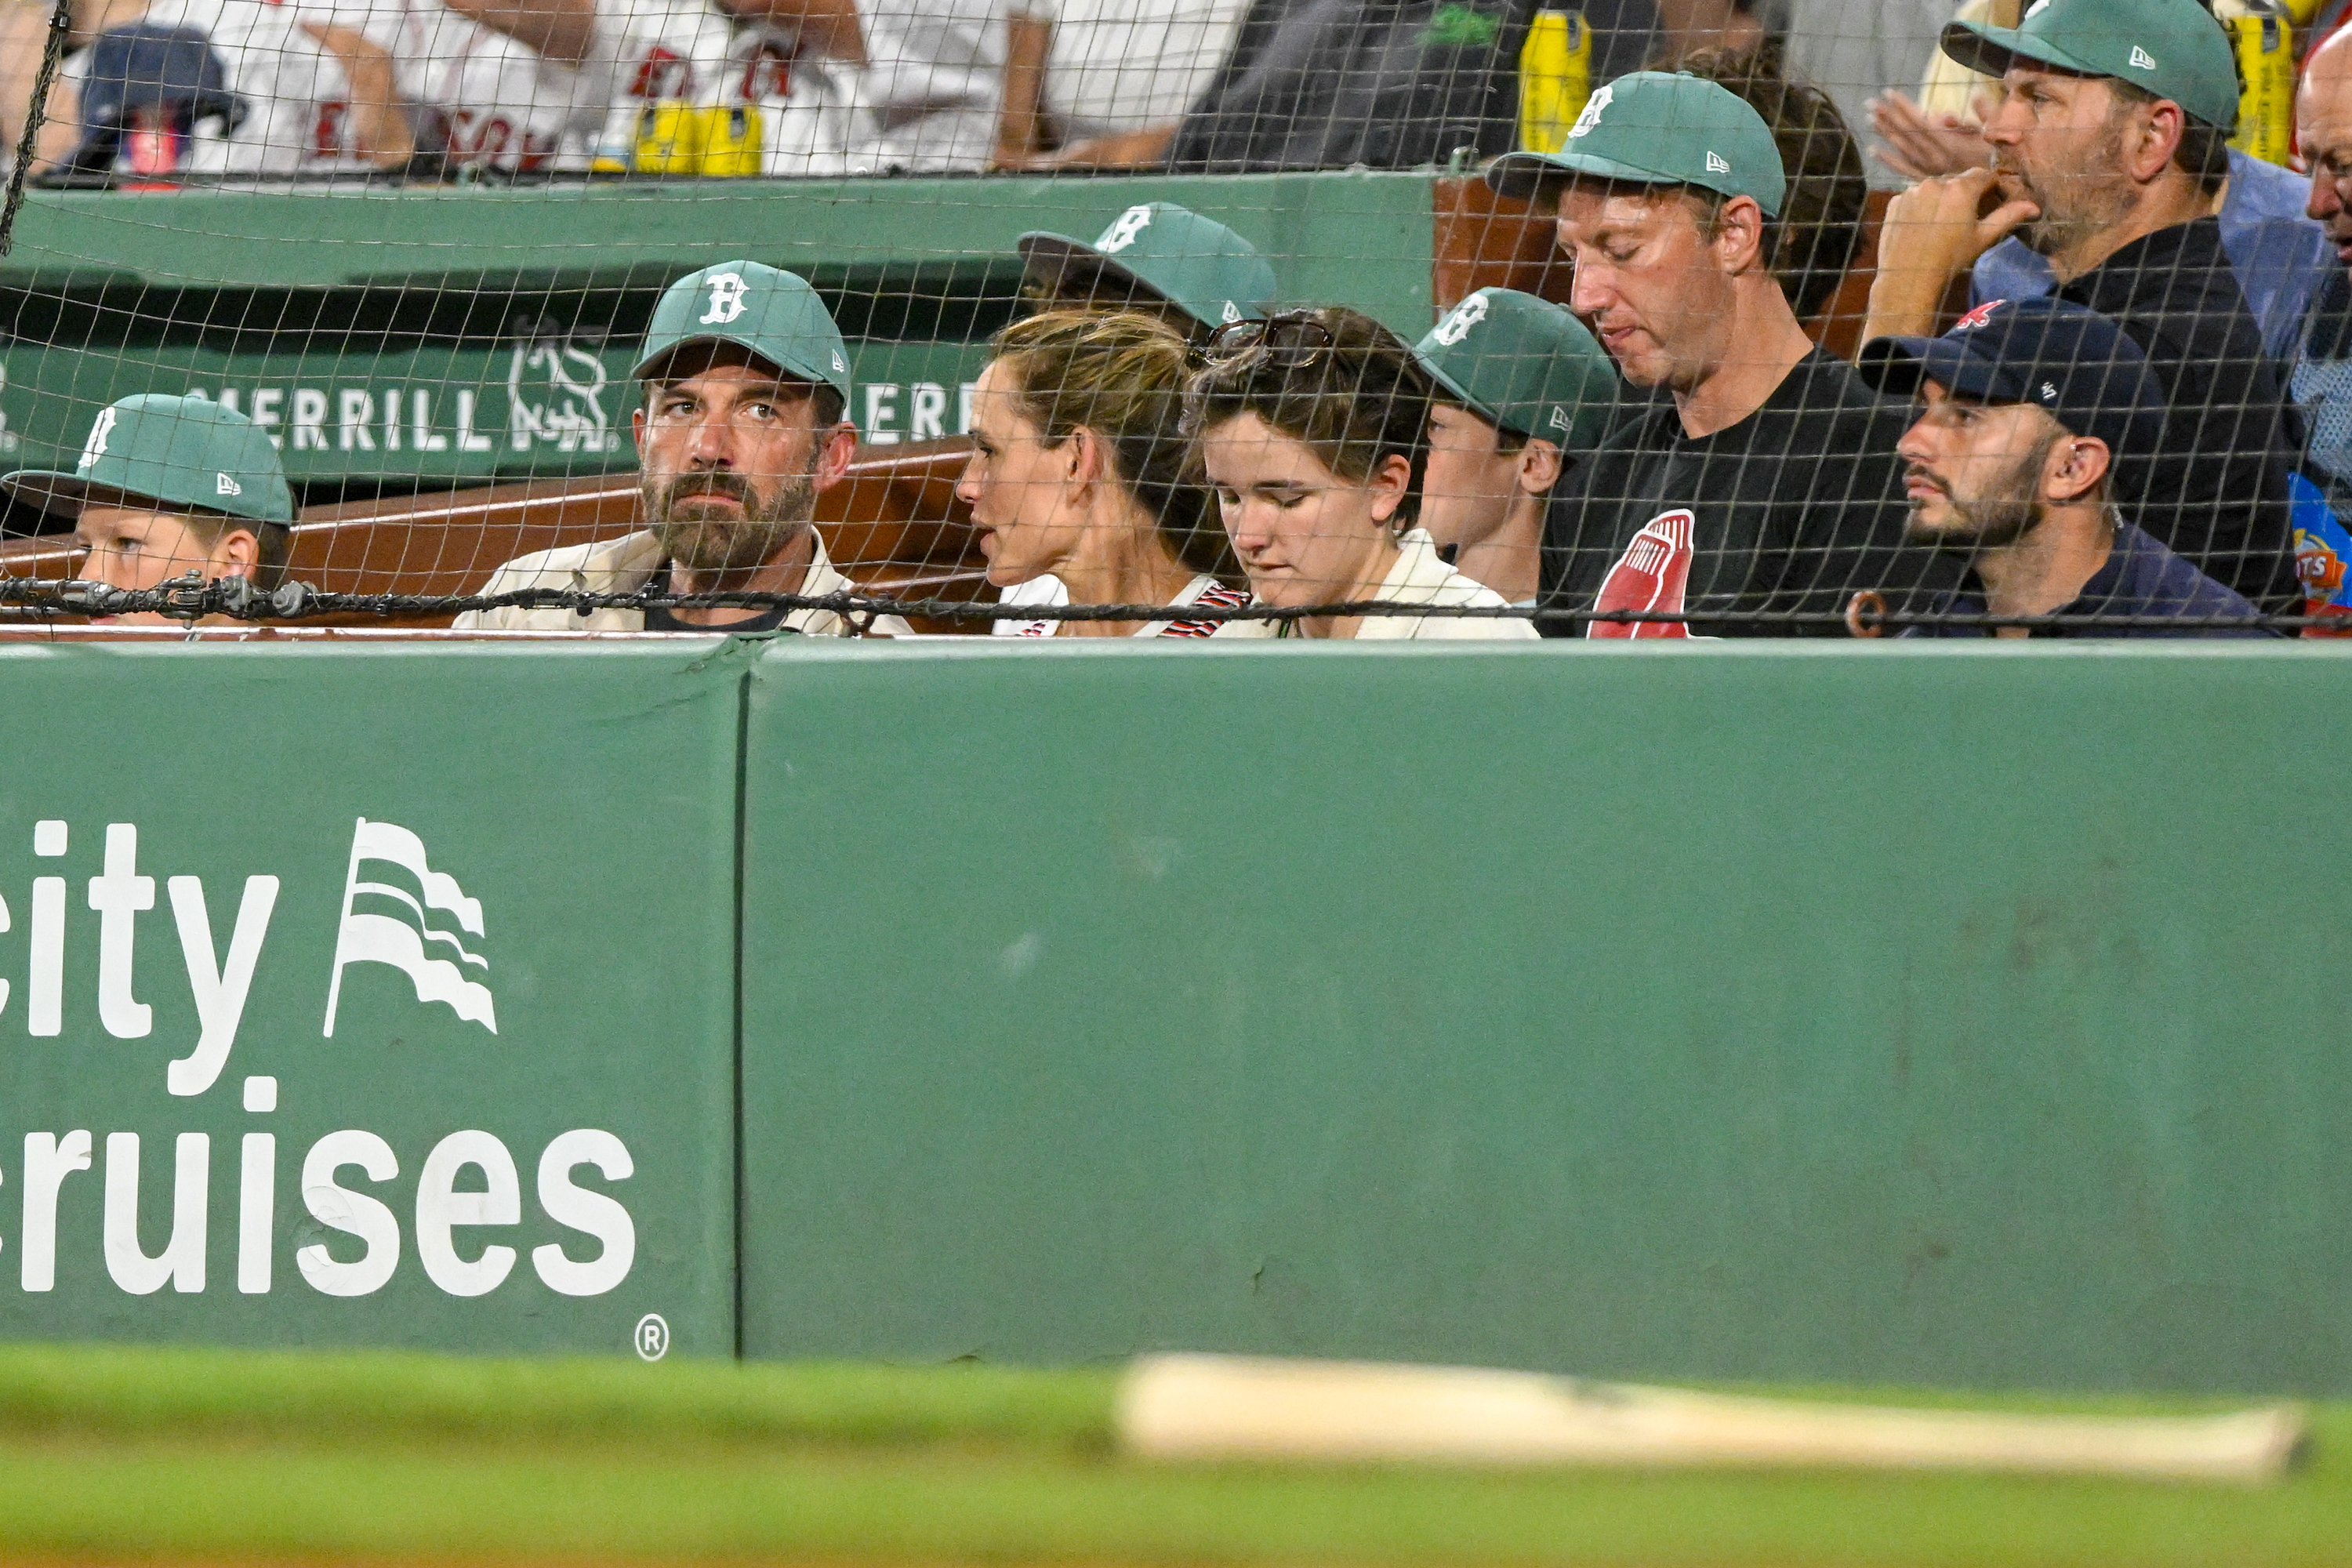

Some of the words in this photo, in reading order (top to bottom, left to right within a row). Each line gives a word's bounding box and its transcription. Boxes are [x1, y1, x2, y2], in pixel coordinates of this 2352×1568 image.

[1094, 205, 1152, 253] B
[699, 272, 750, 324] B
[1433, 292, 1489, 346] B
[186, 387, 492, 452] ERRILL
[0, 820, 280, 1096] ity
[0, 1076, 636, 1297] ruises
